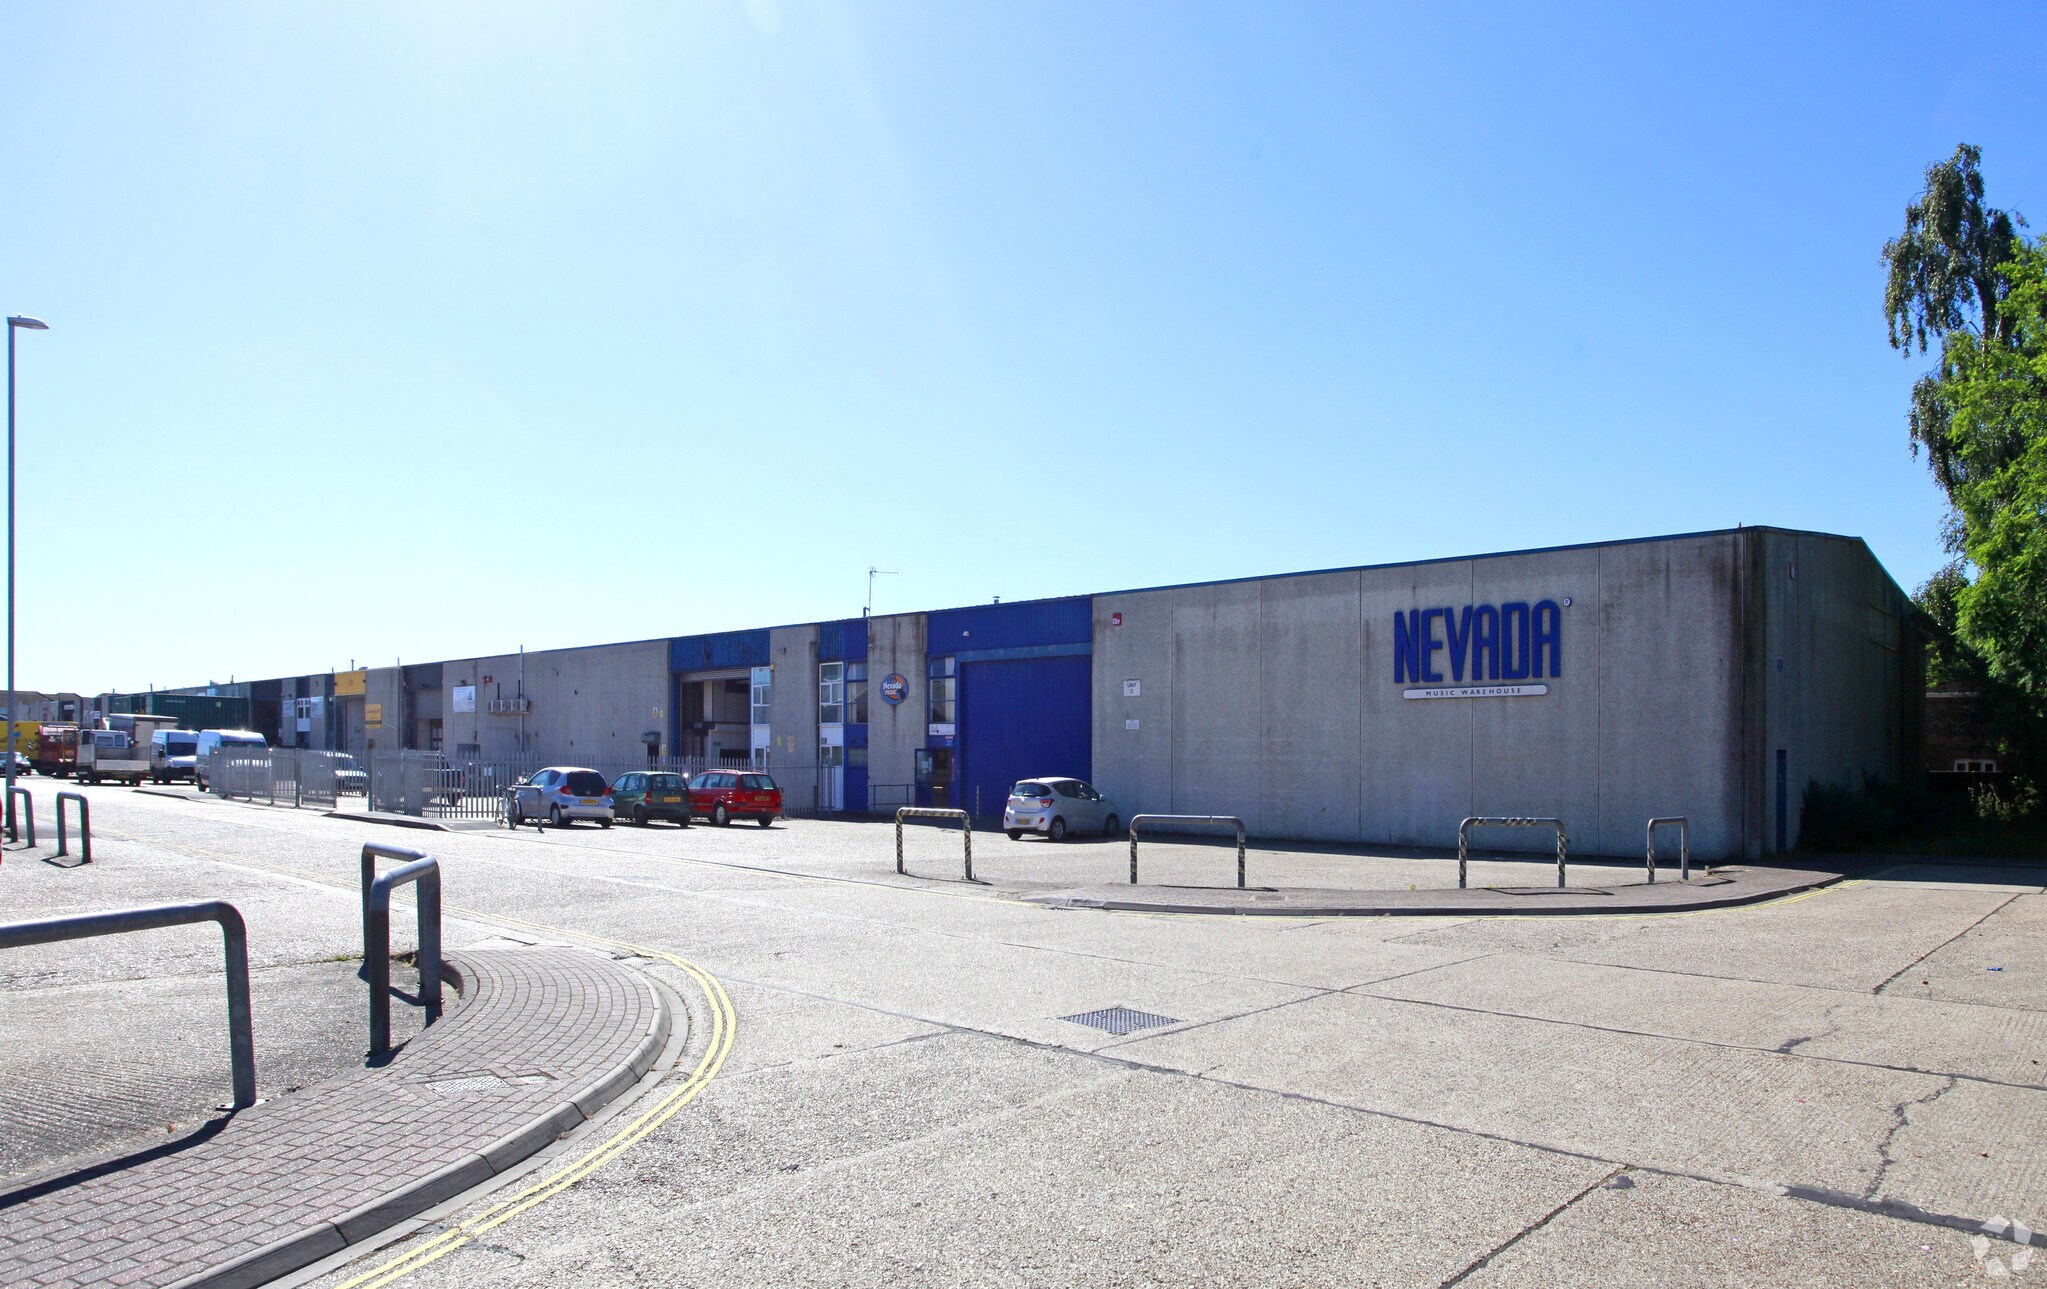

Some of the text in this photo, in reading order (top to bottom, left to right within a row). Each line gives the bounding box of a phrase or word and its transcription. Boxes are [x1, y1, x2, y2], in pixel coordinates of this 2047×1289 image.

[1394, 599, 1561, 683] NEVADA
[883, 681, 901, 690] Nevada
[1461, 687, 1522, 695] WAREHOUSE
